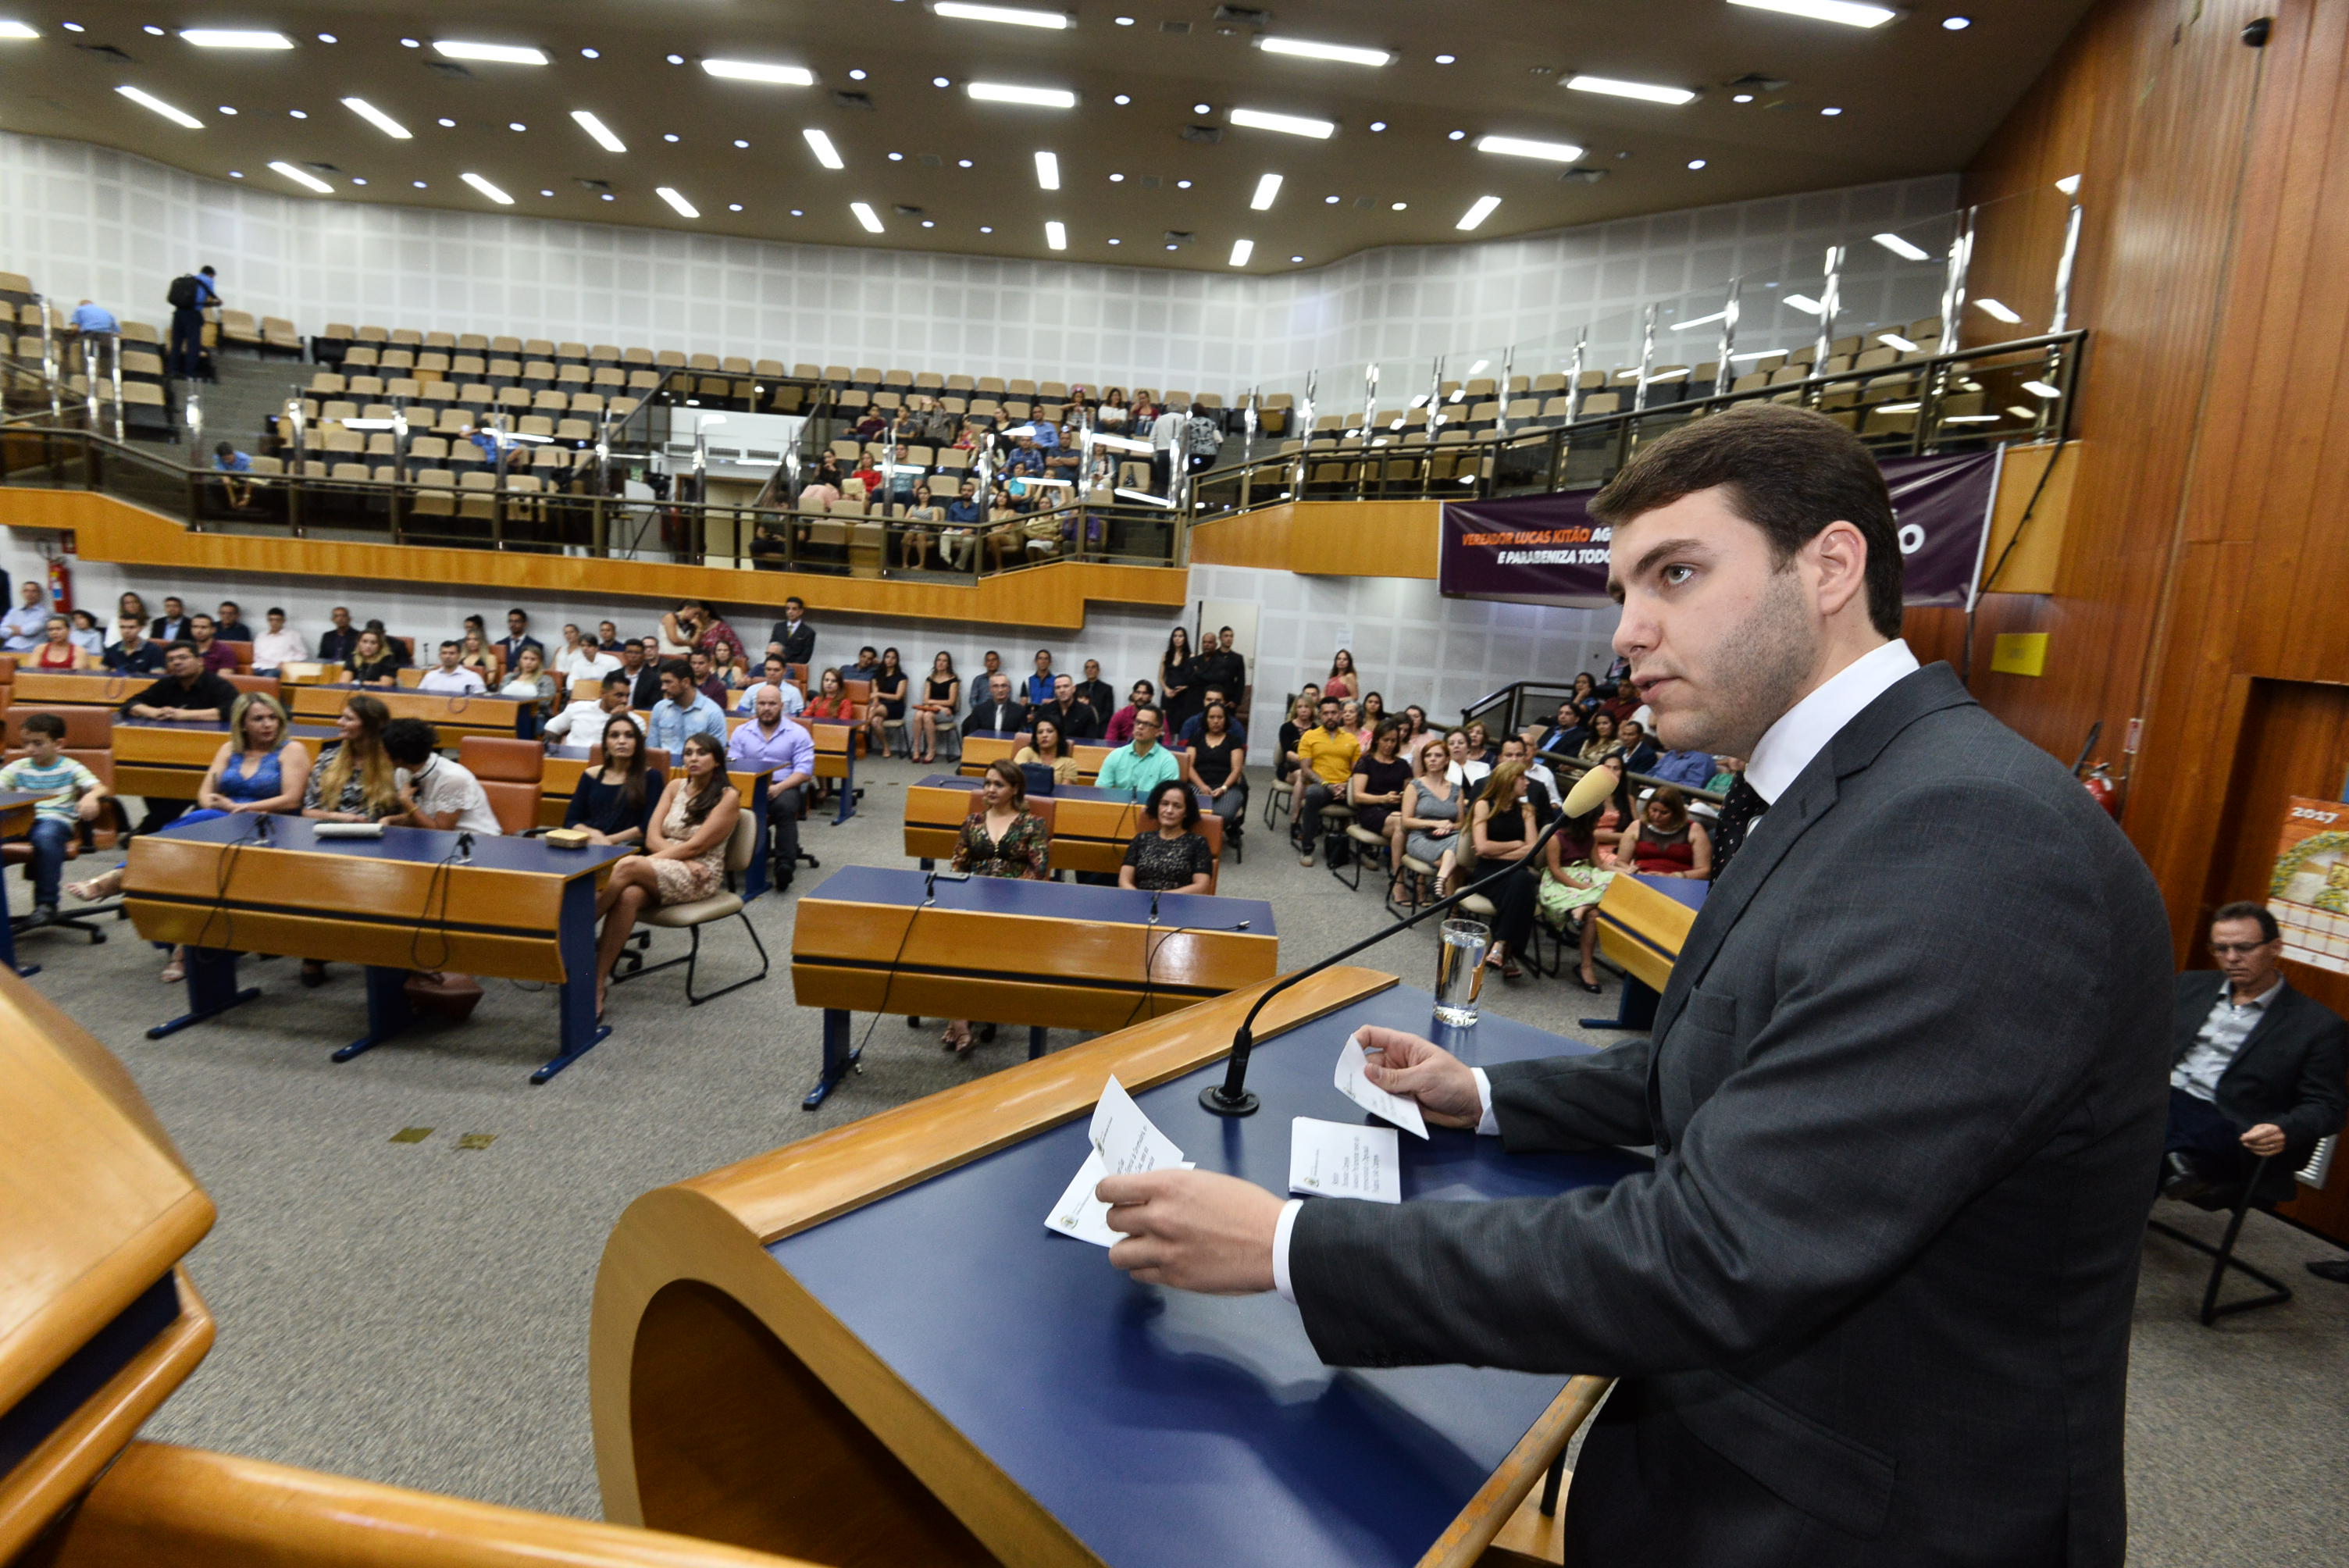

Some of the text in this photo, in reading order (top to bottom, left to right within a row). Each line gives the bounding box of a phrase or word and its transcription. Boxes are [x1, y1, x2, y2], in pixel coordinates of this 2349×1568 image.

[1463, 533, 1513, 545] VEREADOR
[1514, 530, 1552, 544] LUCAS
[1552, 526, 1591, 543] KITÃO
[1497, 551, 1506, 564] E
[1506, 550, 1576, 565] PARABENIZA
[2291, 807, 2339, 824] 2017
